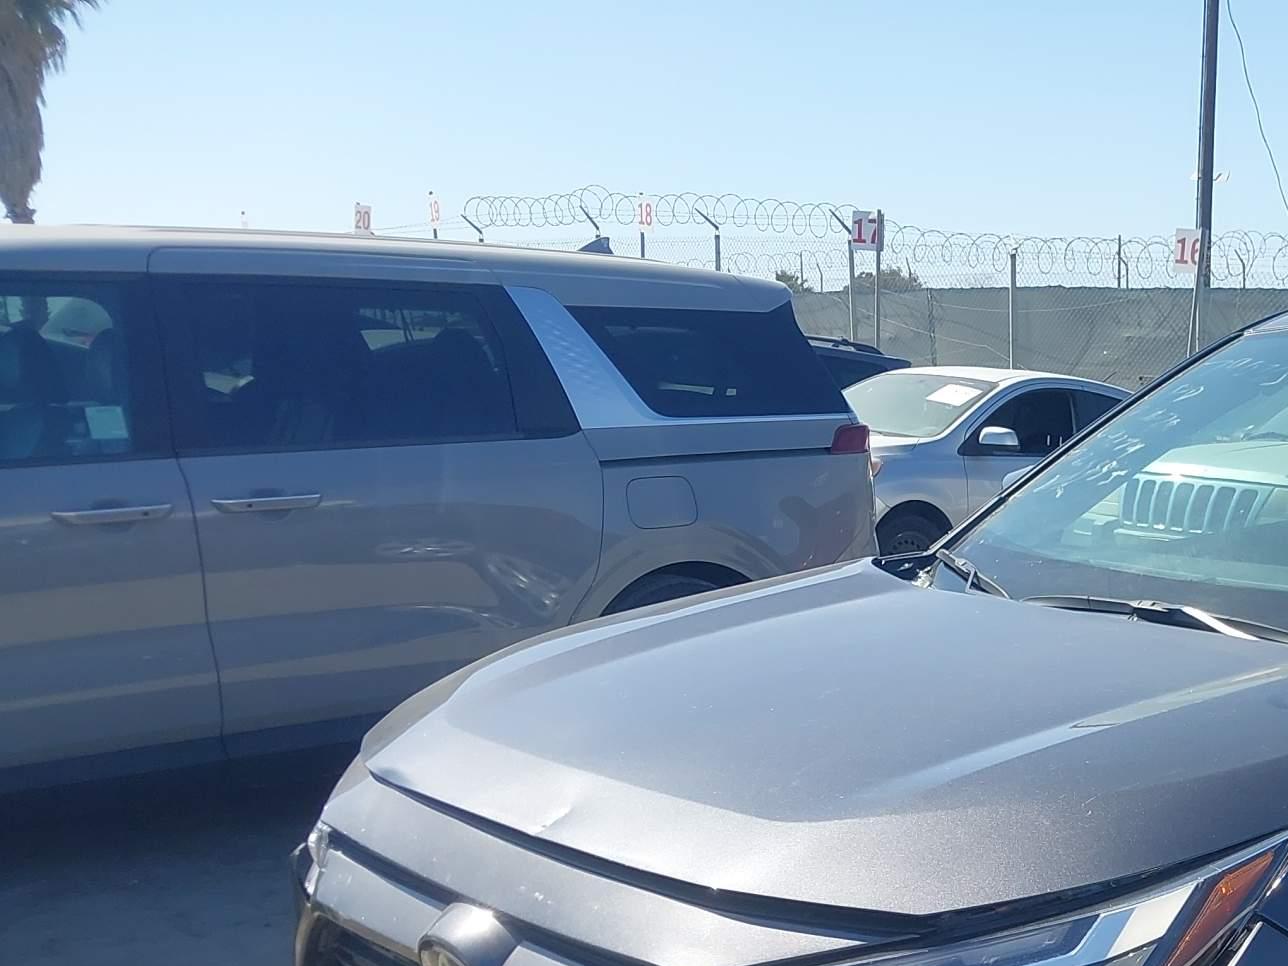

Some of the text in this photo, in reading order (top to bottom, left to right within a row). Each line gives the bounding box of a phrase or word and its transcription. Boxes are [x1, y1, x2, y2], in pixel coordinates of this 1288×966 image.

[355, 210, 371, 230] 20
[430, 200, 440, 222] 19
[638, 203, 652, 226] 18
[852, 218, 877, 244] 17
